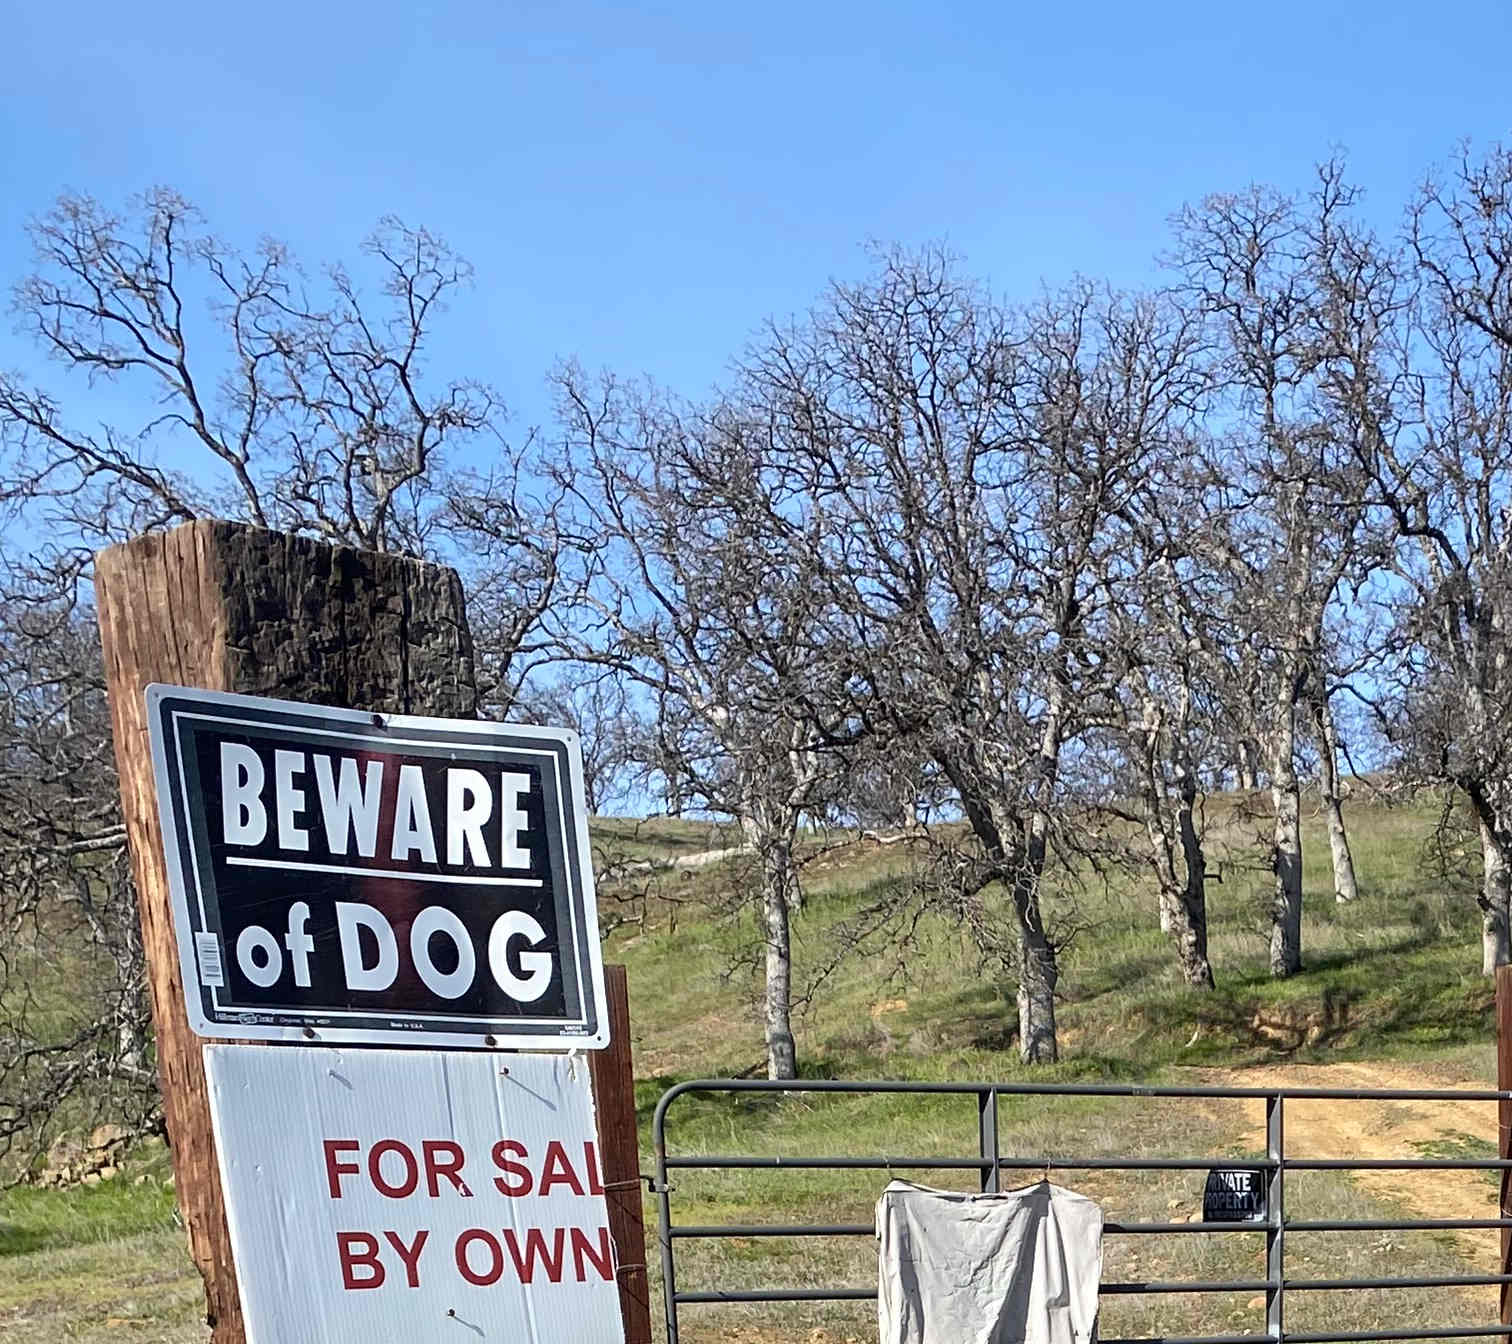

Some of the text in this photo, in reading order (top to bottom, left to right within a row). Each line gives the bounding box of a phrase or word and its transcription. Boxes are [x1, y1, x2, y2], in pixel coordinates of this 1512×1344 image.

[220, 741, 532, 870] BEWARE
[235, 901, 553, 1003] of DOG
[322, 1138, 475, 1199] FOR
[336, 1226, 615, 1291] BY OWN
